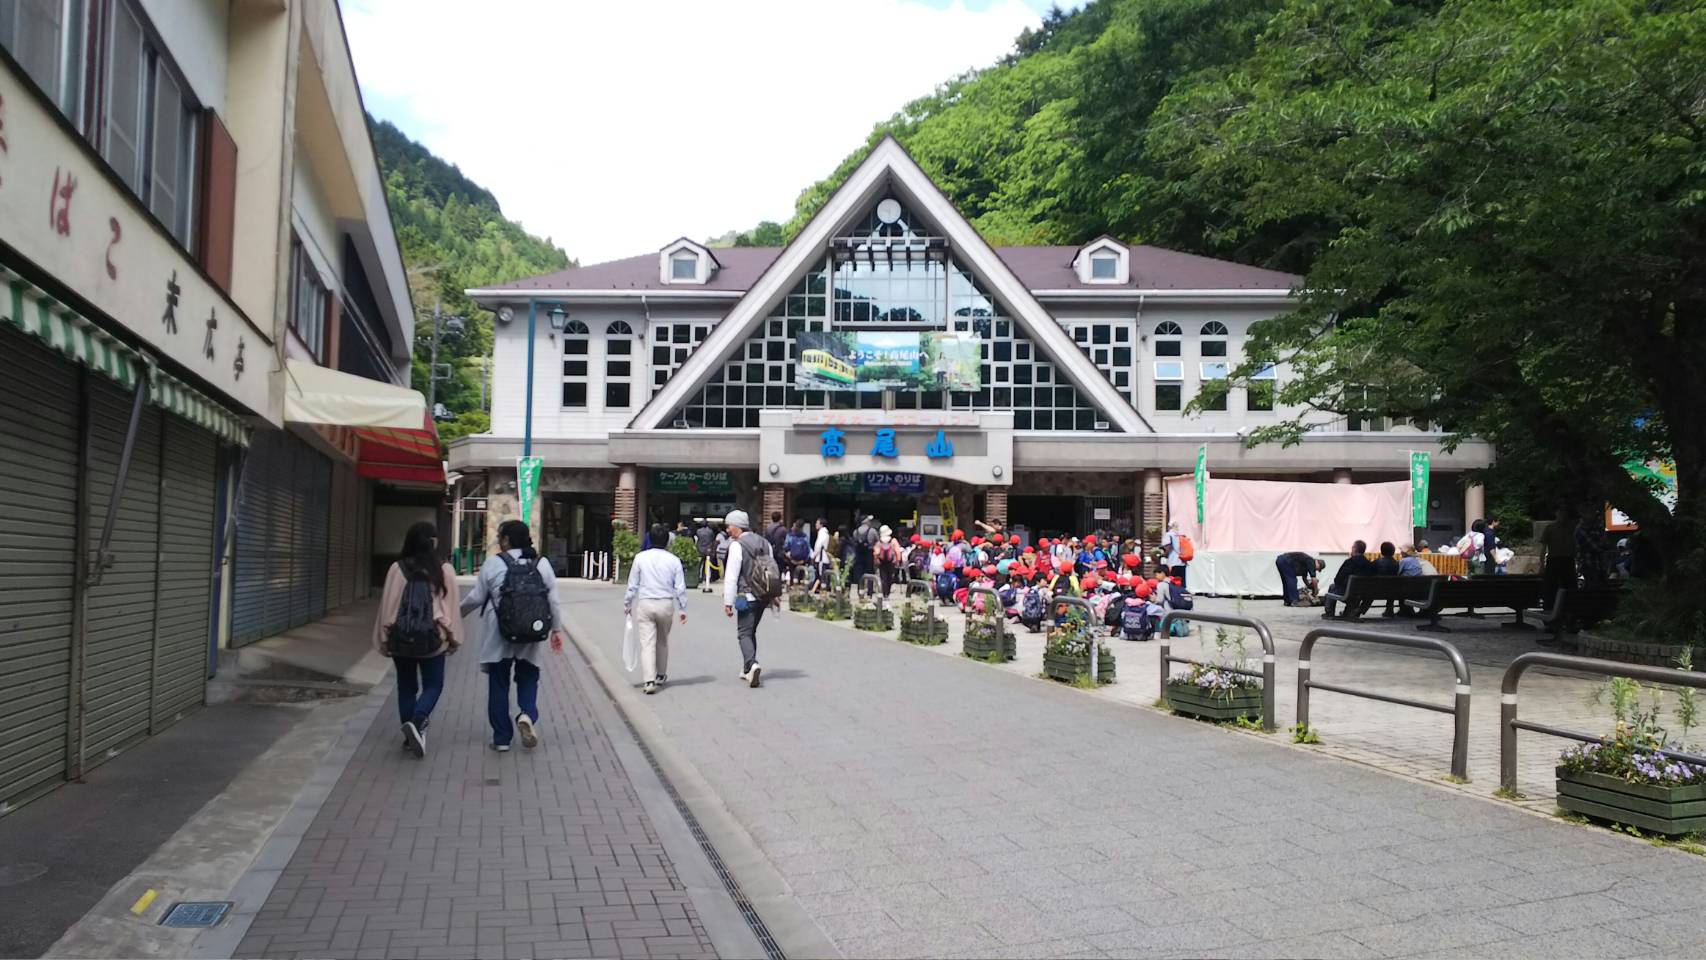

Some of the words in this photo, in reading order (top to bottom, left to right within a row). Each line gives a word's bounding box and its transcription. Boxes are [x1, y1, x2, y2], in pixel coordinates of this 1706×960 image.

[820, 427, 954, 458] 高尾山
[659, 472, 728, 481] ケーブルカーのりば
